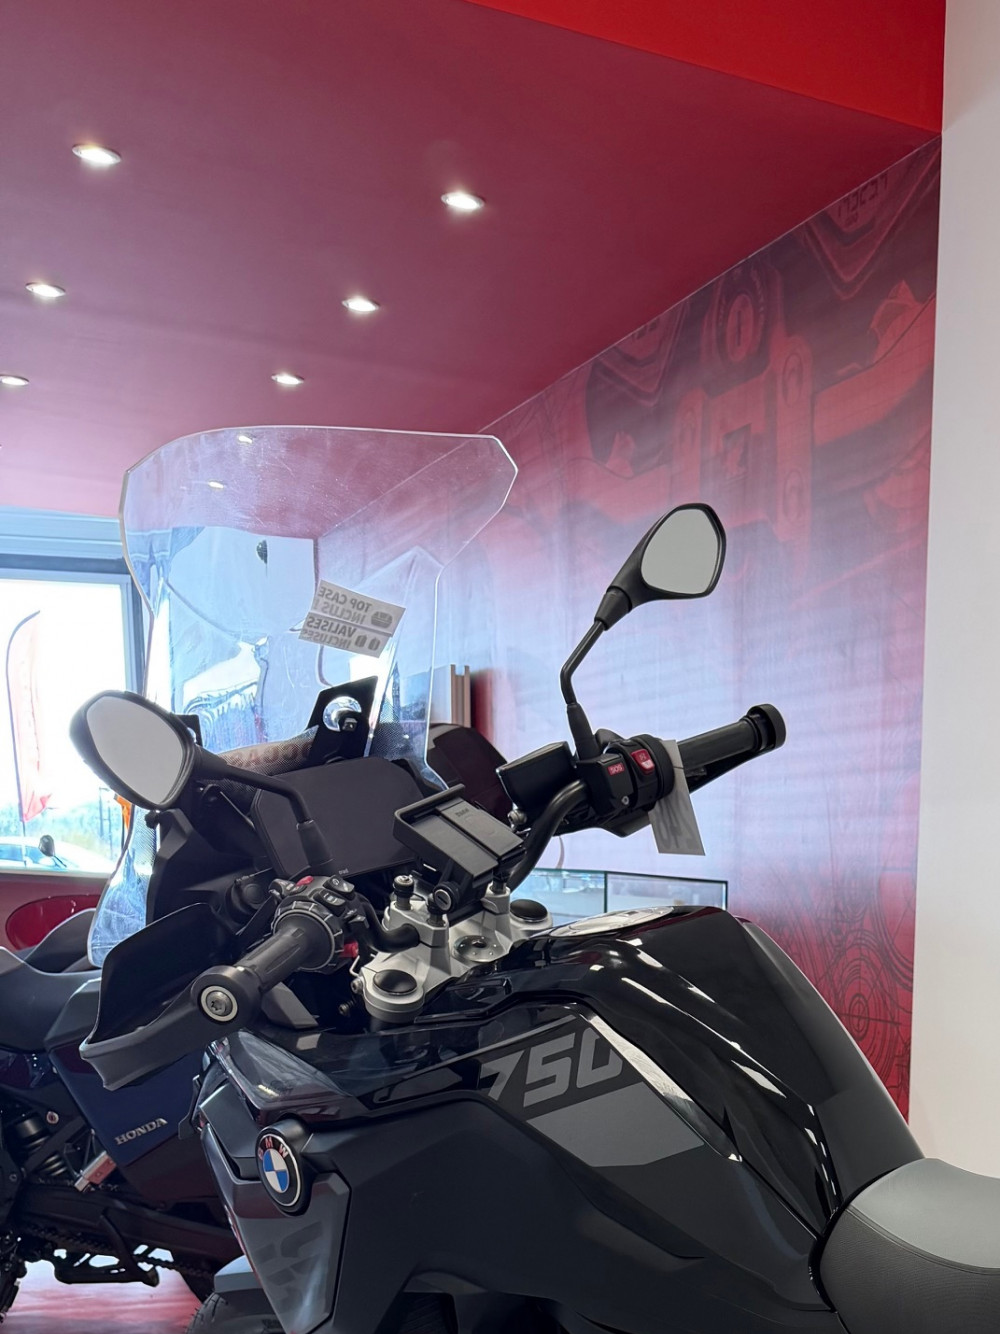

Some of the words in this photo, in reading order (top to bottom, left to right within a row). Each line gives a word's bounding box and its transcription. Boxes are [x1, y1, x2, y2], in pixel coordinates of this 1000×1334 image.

[479, 1027, 623, 1108] 750
[115, 1118, 168, 1146] HONDA
[257, 1136, 288, 1160] BMW
